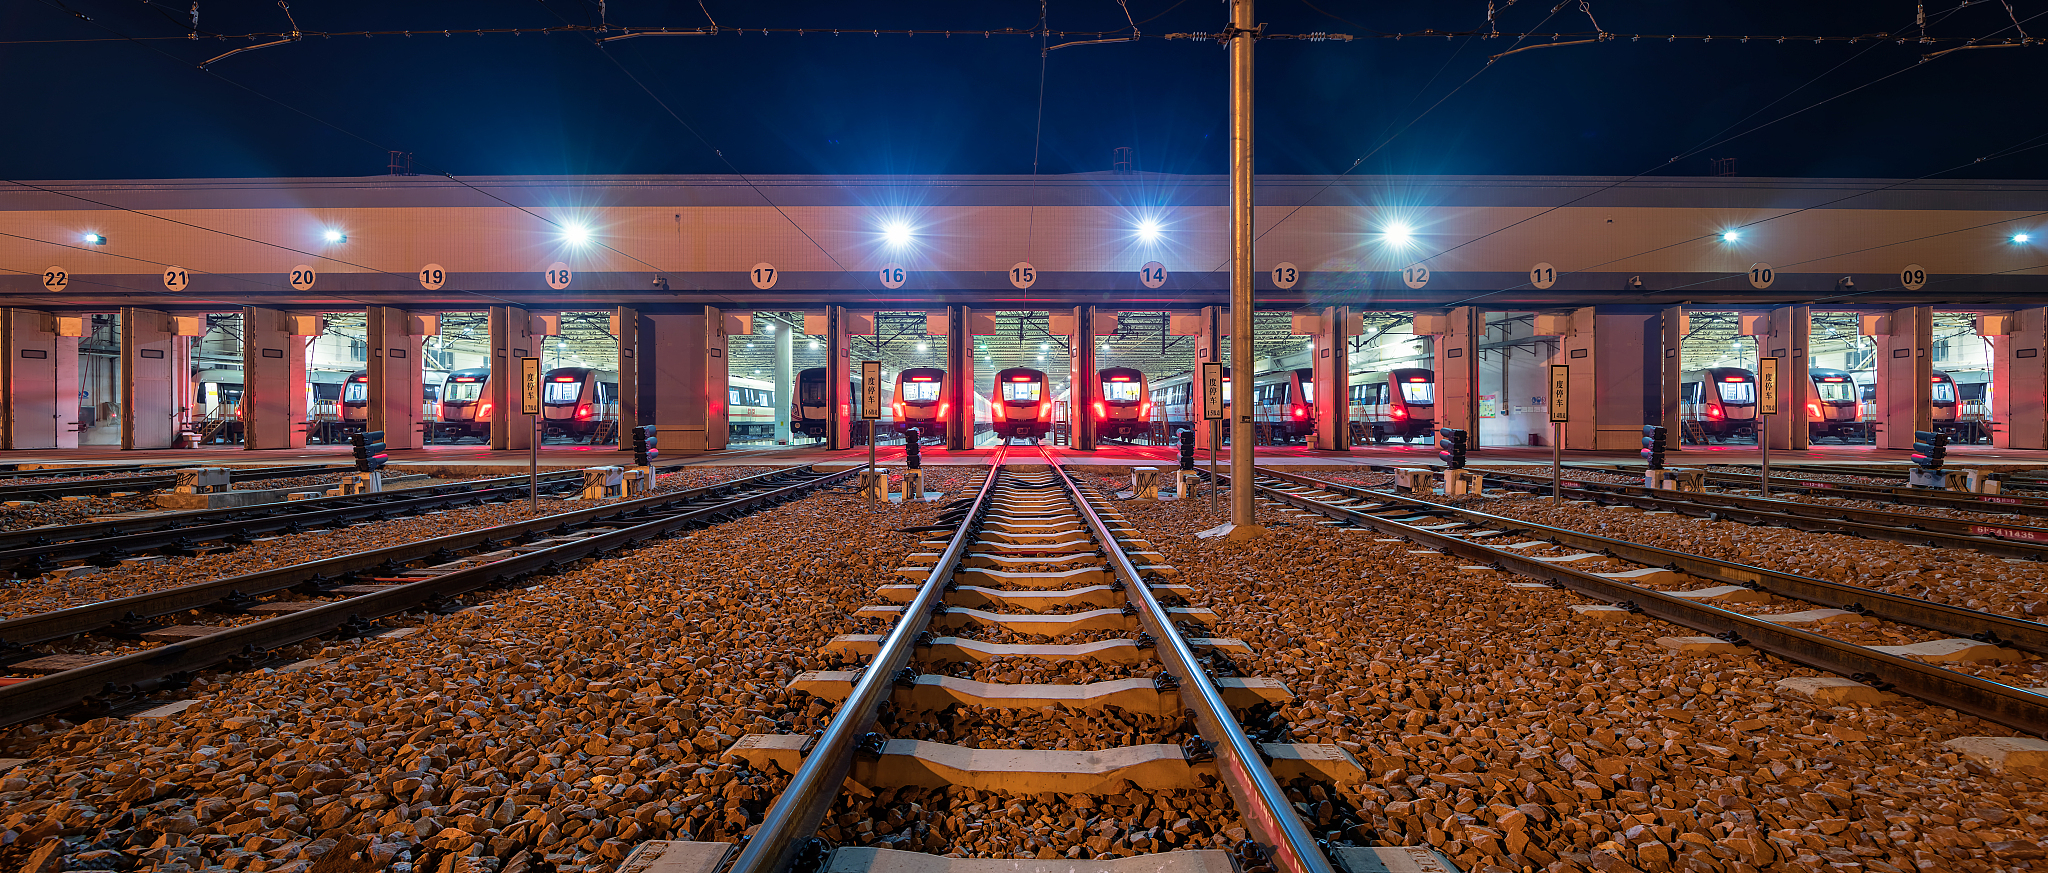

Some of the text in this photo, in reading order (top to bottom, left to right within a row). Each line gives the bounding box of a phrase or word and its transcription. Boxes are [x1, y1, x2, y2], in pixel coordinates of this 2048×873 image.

[46, 272, 66, 286] 22
[167, 272, 185, 285] 21
[293, 271, 313, 285] 20
[423, 270, 442, 283] 19
[549, 270, 569, 284] 18
[754, 269, 773, 282] 17
[883, 269, 903, 282] 16
[1013, 269, 1033, 282] 15
[1143, 269, 1163, 282] 14
[1276, 268, 1295, 282] 13
[1407, 269, 1427, 282] 12
[1534, 269, 1552, 282] 11
[1752, 269, 1771, 282] 10
[1903, 270, 1924, 284] 09
[1209, 372, 1217, 405] 一度停车
